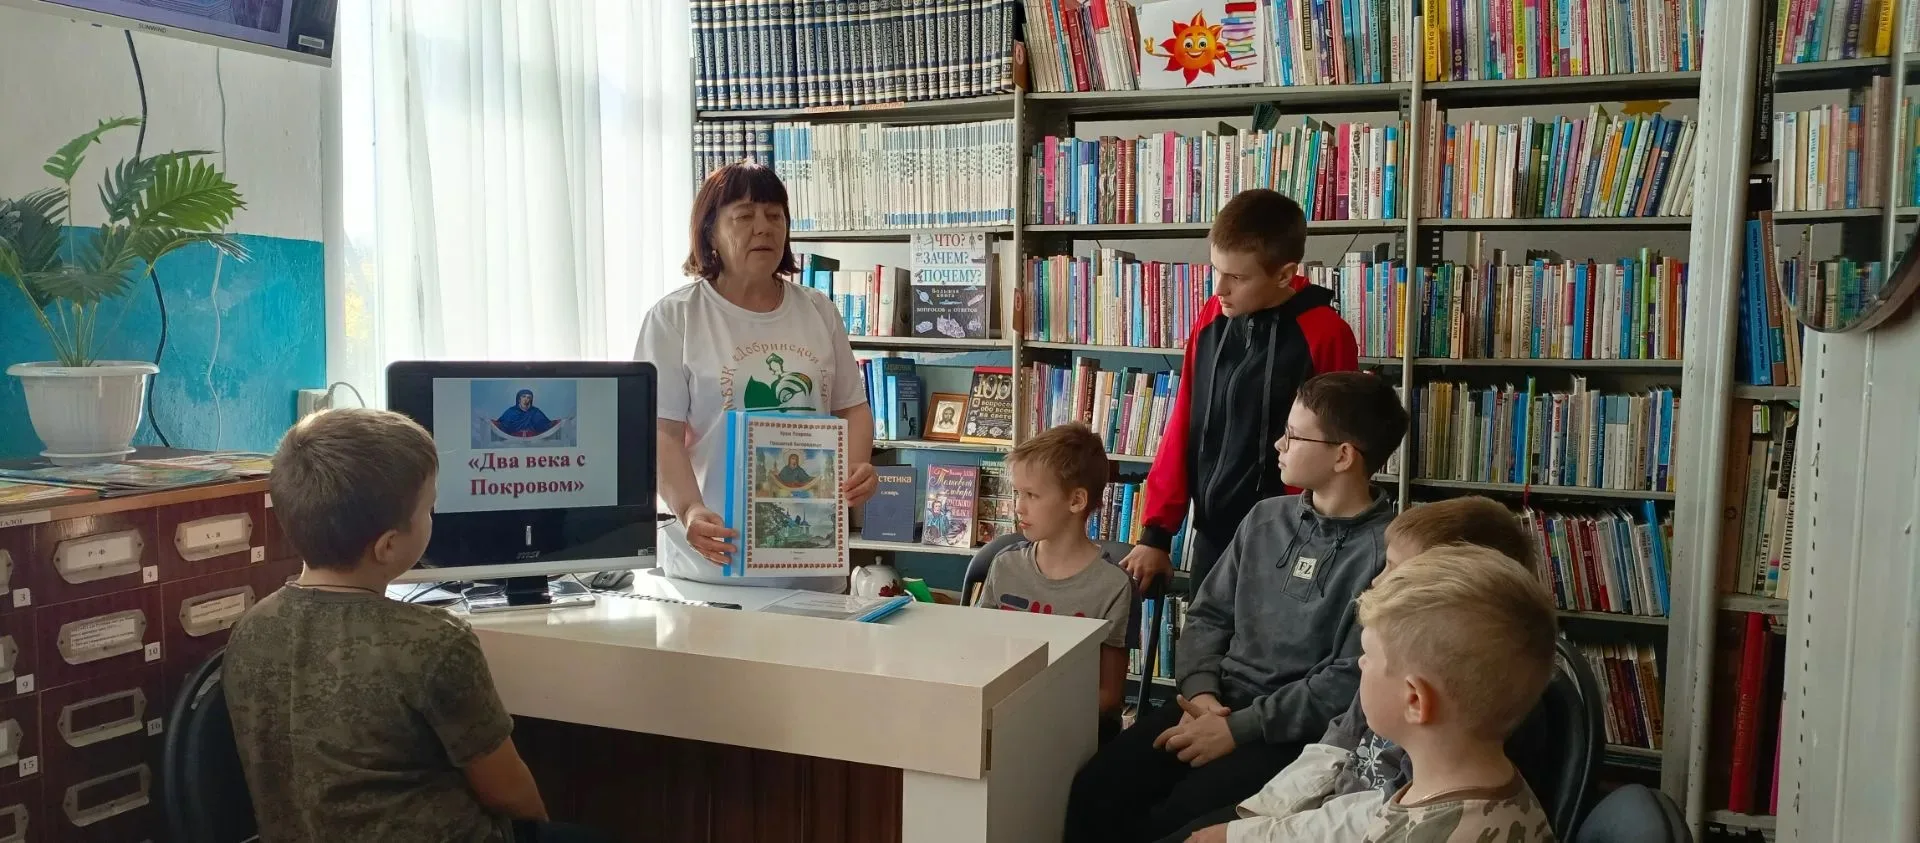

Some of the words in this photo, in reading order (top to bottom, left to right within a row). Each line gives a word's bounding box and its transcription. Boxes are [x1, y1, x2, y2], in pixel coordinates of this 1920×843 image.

[1454, 49, 1462, 66] 100
[1762, 94, 1770, 124] ДЕТСТВА
[935, 234, 965, 246] ЧТО?
[924, 252, 968, 264] ЗАЧЕМ?
[923, 270, 981, 282] ПОЧЕМУ?
[468, 453, 519, 472] «Два
[526, 456, 570, 468] века
[576, 454, 586, 466] с
[876, 474, 911, 483] стетика
[932, 468, 972, 485] Толковый
[470, 479, 584, 498] Покровом»
[23, 761, 34, 770] 15
